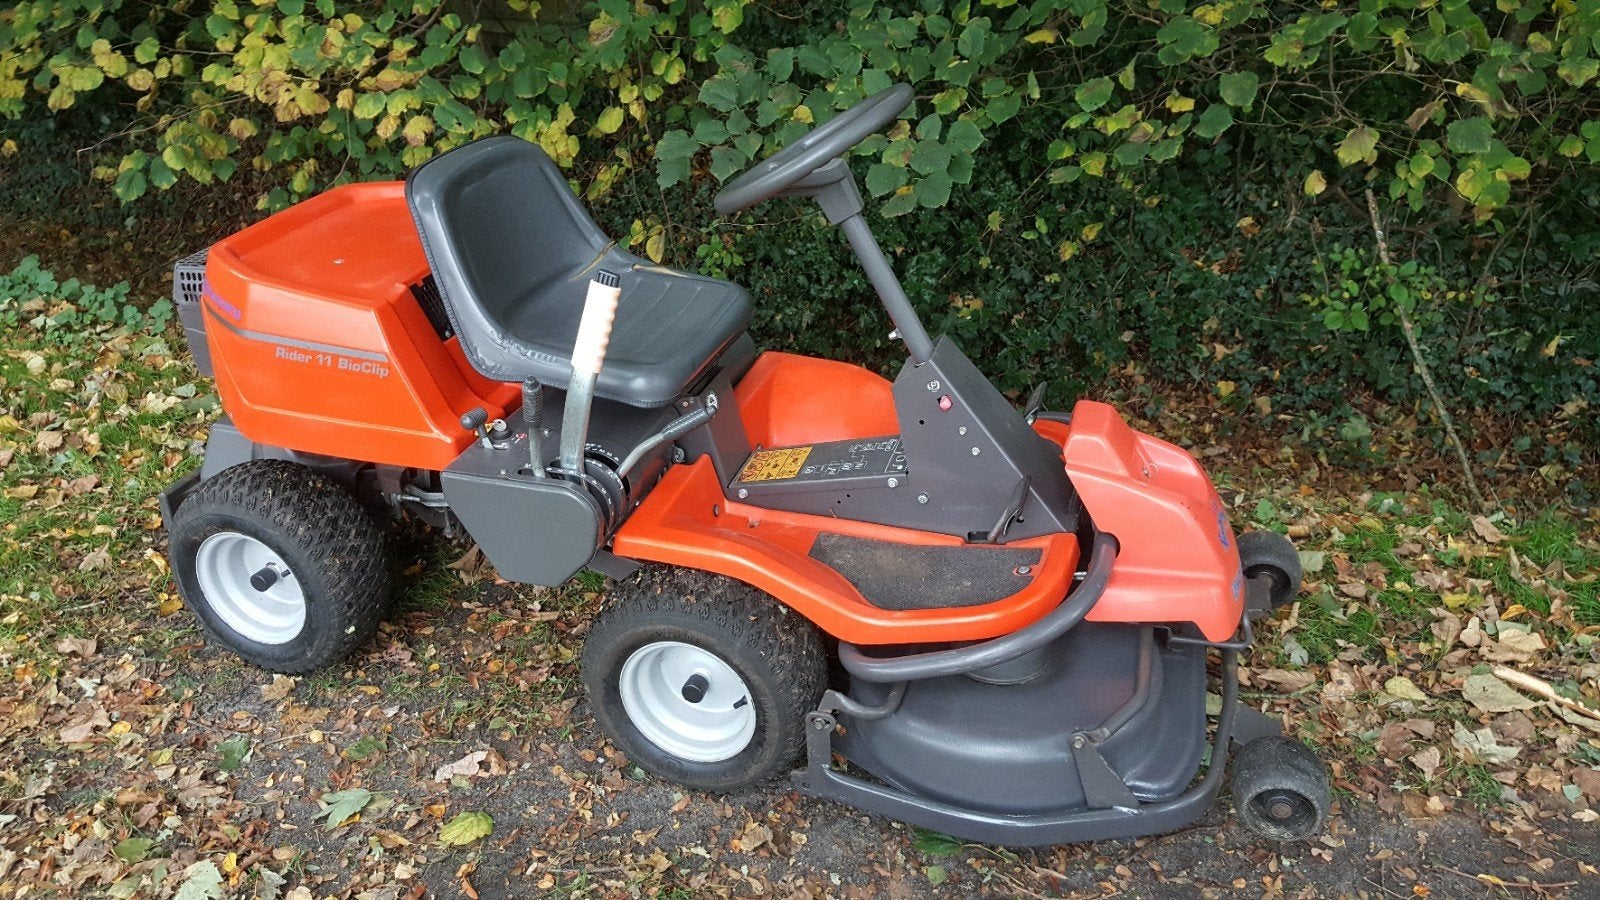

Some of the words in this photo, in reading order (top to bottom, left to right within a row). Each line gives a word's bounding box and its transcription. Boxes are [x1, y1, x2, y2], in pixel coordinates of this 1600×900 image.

[275, 346, 312, 363] Rider
[316, 353, 332, 367] 11
[338, 357, 389, 378] BioClip
